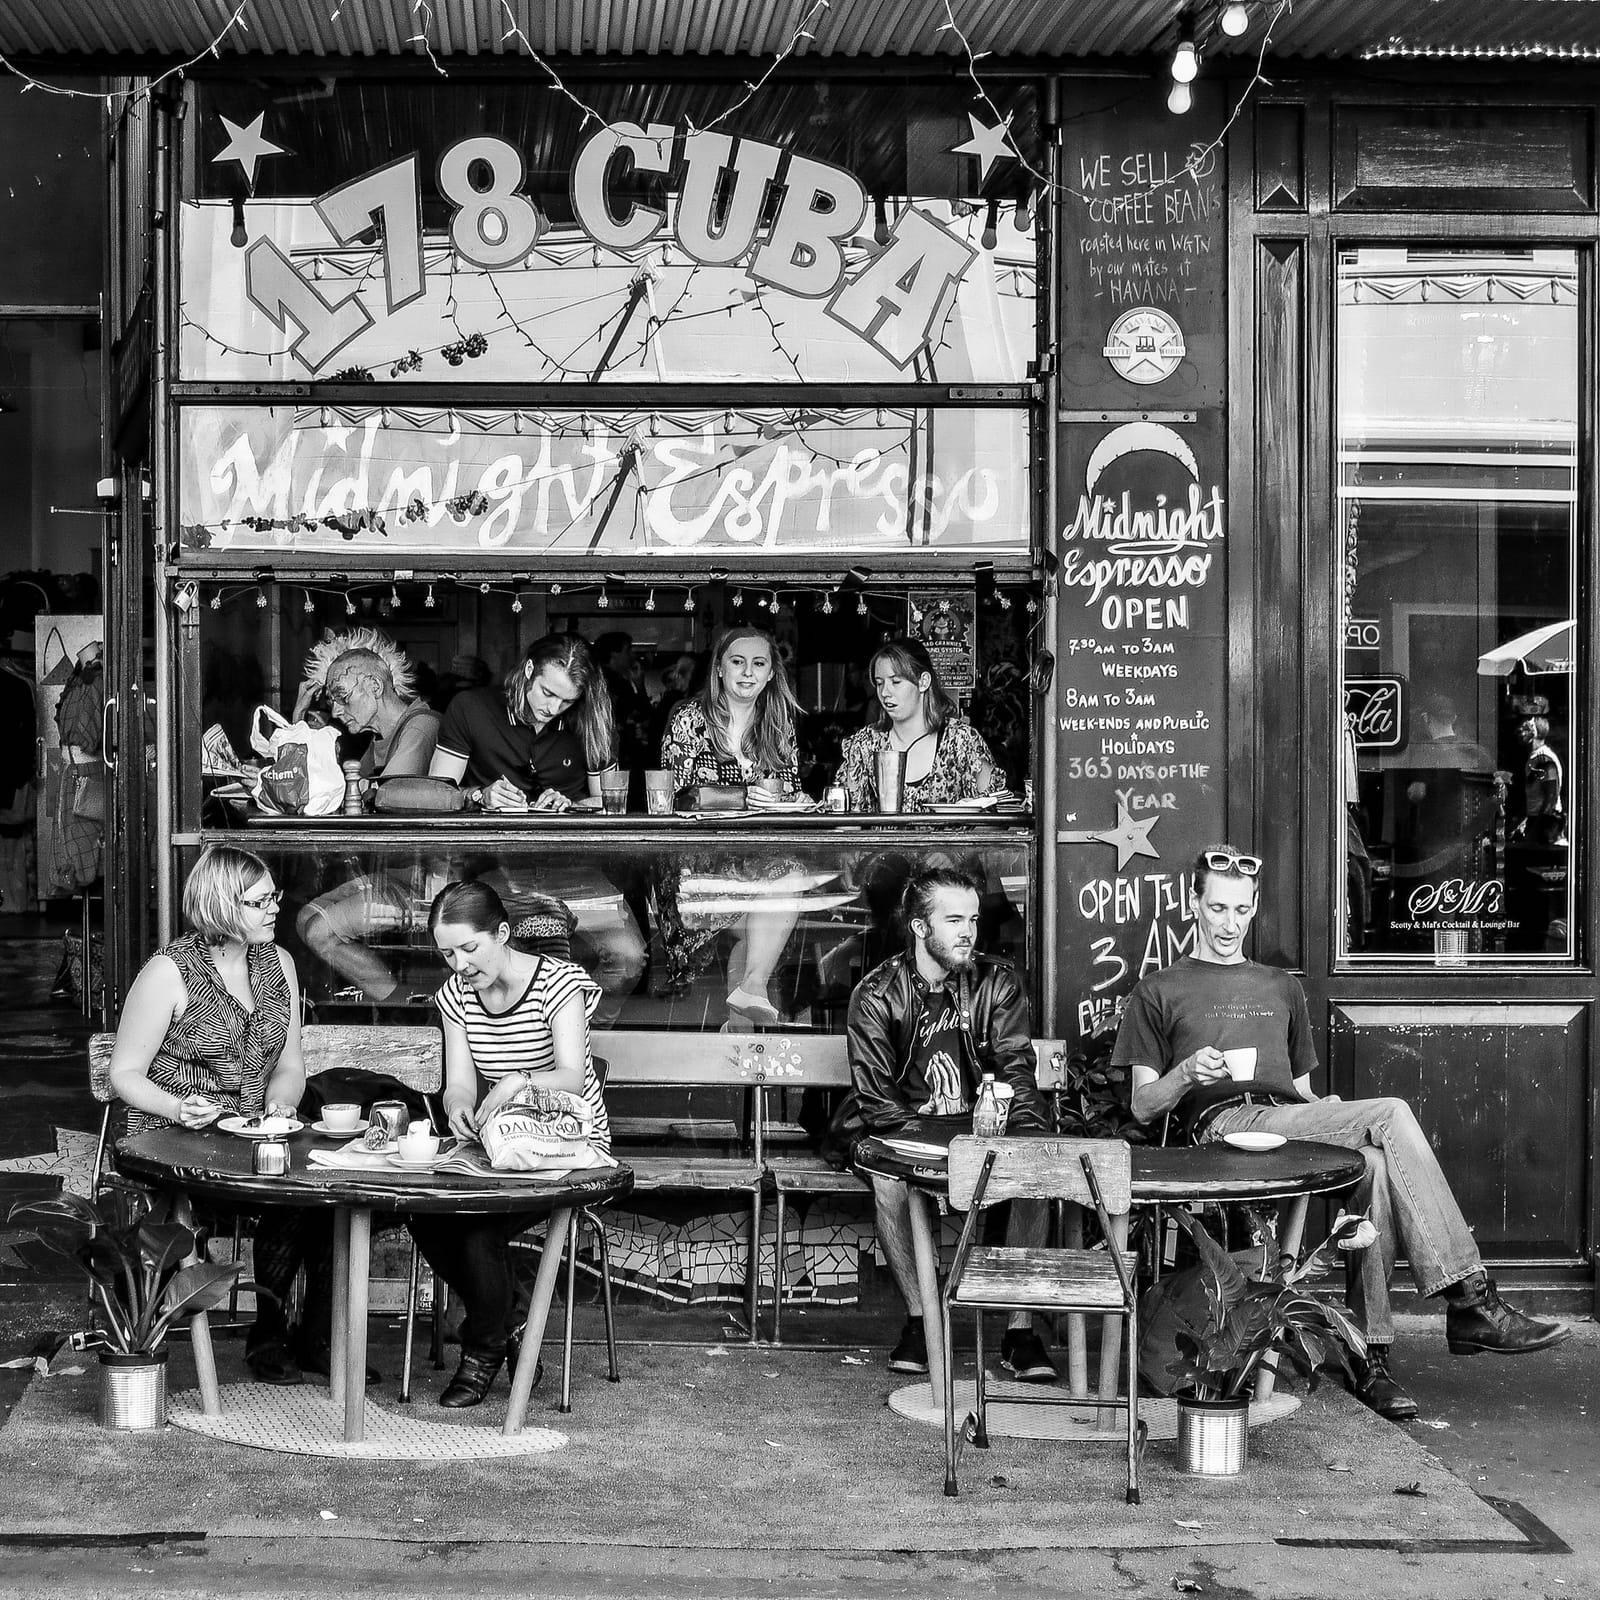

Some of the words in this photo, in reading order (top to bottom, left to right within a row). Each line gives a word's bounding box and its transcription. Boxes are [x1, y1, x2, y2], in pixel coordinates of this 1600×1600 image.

[1080, 154, 1111, 190] WE
[1120, 151, 1175, 186] SELL
[1089, 192, 1154, 224] COFFEE
[245, 134, 541, 374] 178
[570, 120, 978, 370] CUBA
[1080, 232, 1123, 255] roasted
[1126, 234, 1150, 252] here
[1155, 236, 1167, 252] in
[1171, 233, 1211, 255] WGTN
[1089, 258, 1103, 286] by
[1107, 262, 1125, 276] our
[1131, 257, 1168, 277] mates
[1110, 278, 1181, 304] HAVANA
[208, 408, 632, 548] Midnight
[643, 424, 1001, 547] Espresso
[1063, 483, 1224, 554] Midnight
[1064, 549, 1212, 606] Espresso
[1101, 595, 1189, 629] OPEN
[1141, 638, 1175, 653] 3AM
[1102, 662, 1178, 678] WEEKDAYS
[1066, 688, 1099, 708] 8AM
[1104, 693, 1121, 706] TO
[1125, 688, 1156, 706] 3AM
[1060, 716, 1131, 731] WEEK-ENDS
[1135, 717, 1162, 730] AND
[1068, 757, 1113, 779] 363
[1117, 765, 1154, 780] DAYS
[1157, 765, 1178, 778] OF
[1179, 763, 1210, 778] THE
[1114, 787, 1180, 812] YEAR
[1079, 877, 1140, 923] OPEN
[1390, 921, 1412, 930] Scotty
[1442, 920, 1470, 928] Cocktail
[1480, 921, 1506, 930] Lounge
[1090, 936, 1129, 992] 3
[1138, 918, 1198, 980] AM
[499, 1121, 552, 1136] DAUNT
